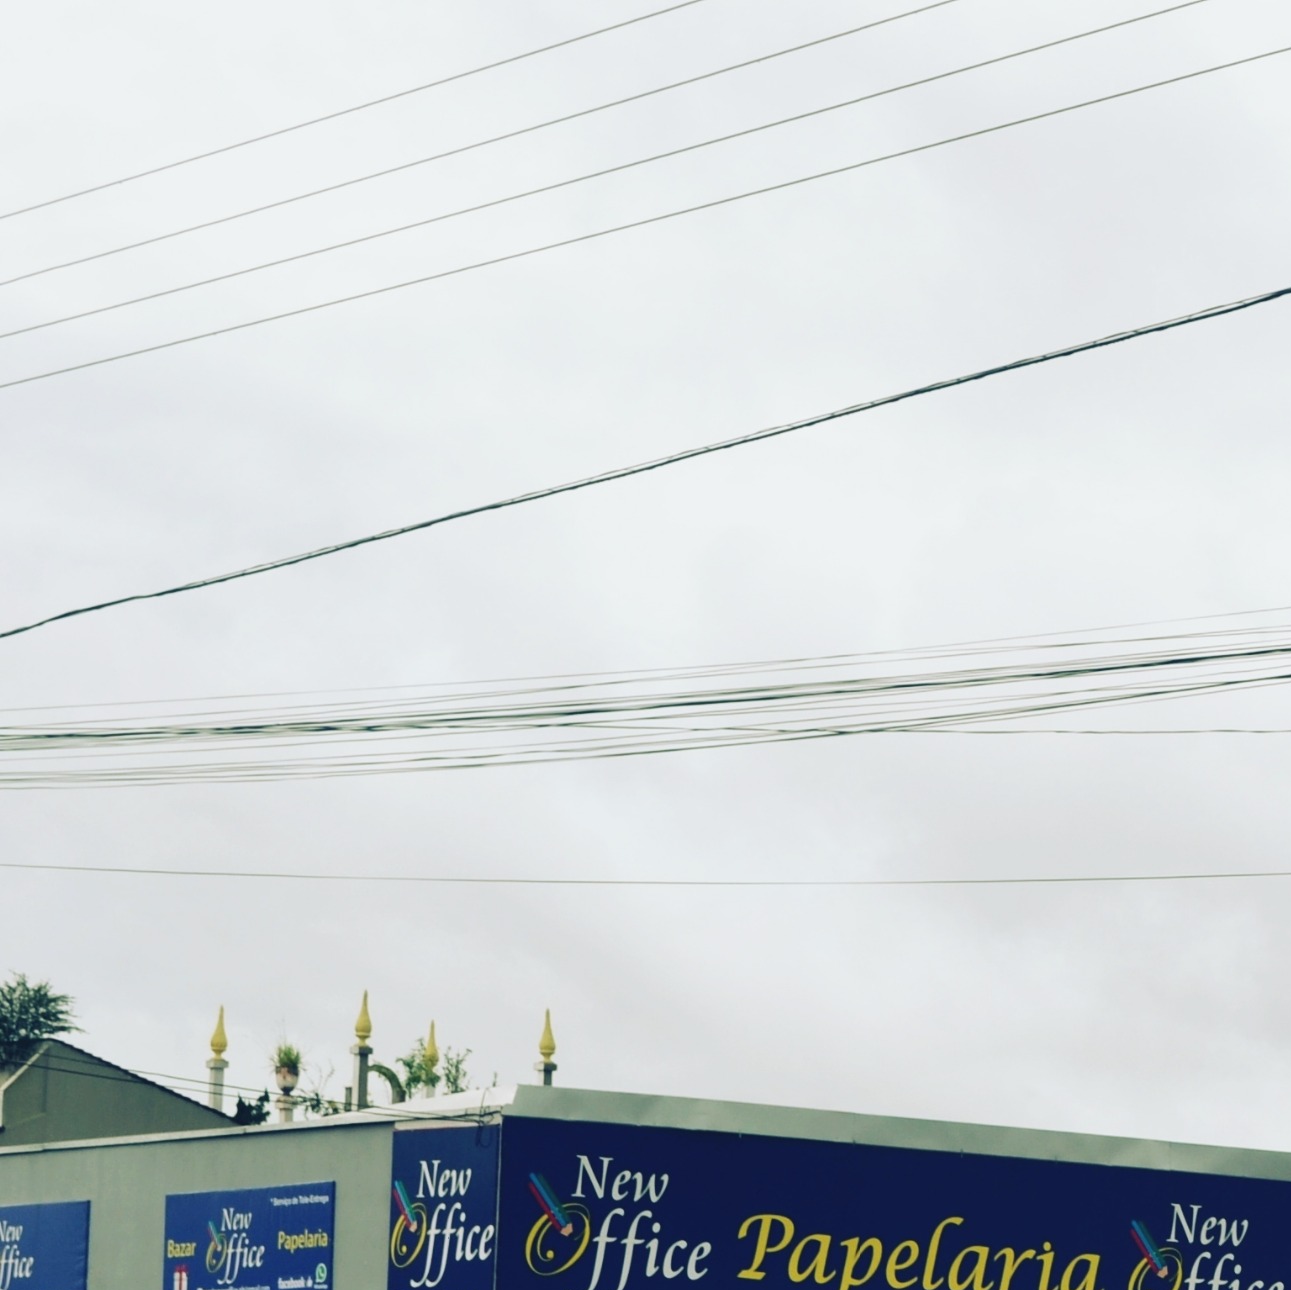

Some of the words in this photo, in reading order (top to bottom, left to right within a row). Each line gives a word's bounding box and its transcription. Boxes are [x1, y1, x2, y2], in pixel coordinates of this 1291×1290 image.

[416, 1159, 472, 1199] New
[571, 1154, 670, 1203] New
[221, 1207, 252, 1231] New
[1166, 1203, 1249, 1248] New
[167, 1239, 197, 1259] Bazar
[206, 1232, 265, 1285] Office
[278, 1228, 328, 1253] Papelaria
[390, 1201, 495, 1289] Office
